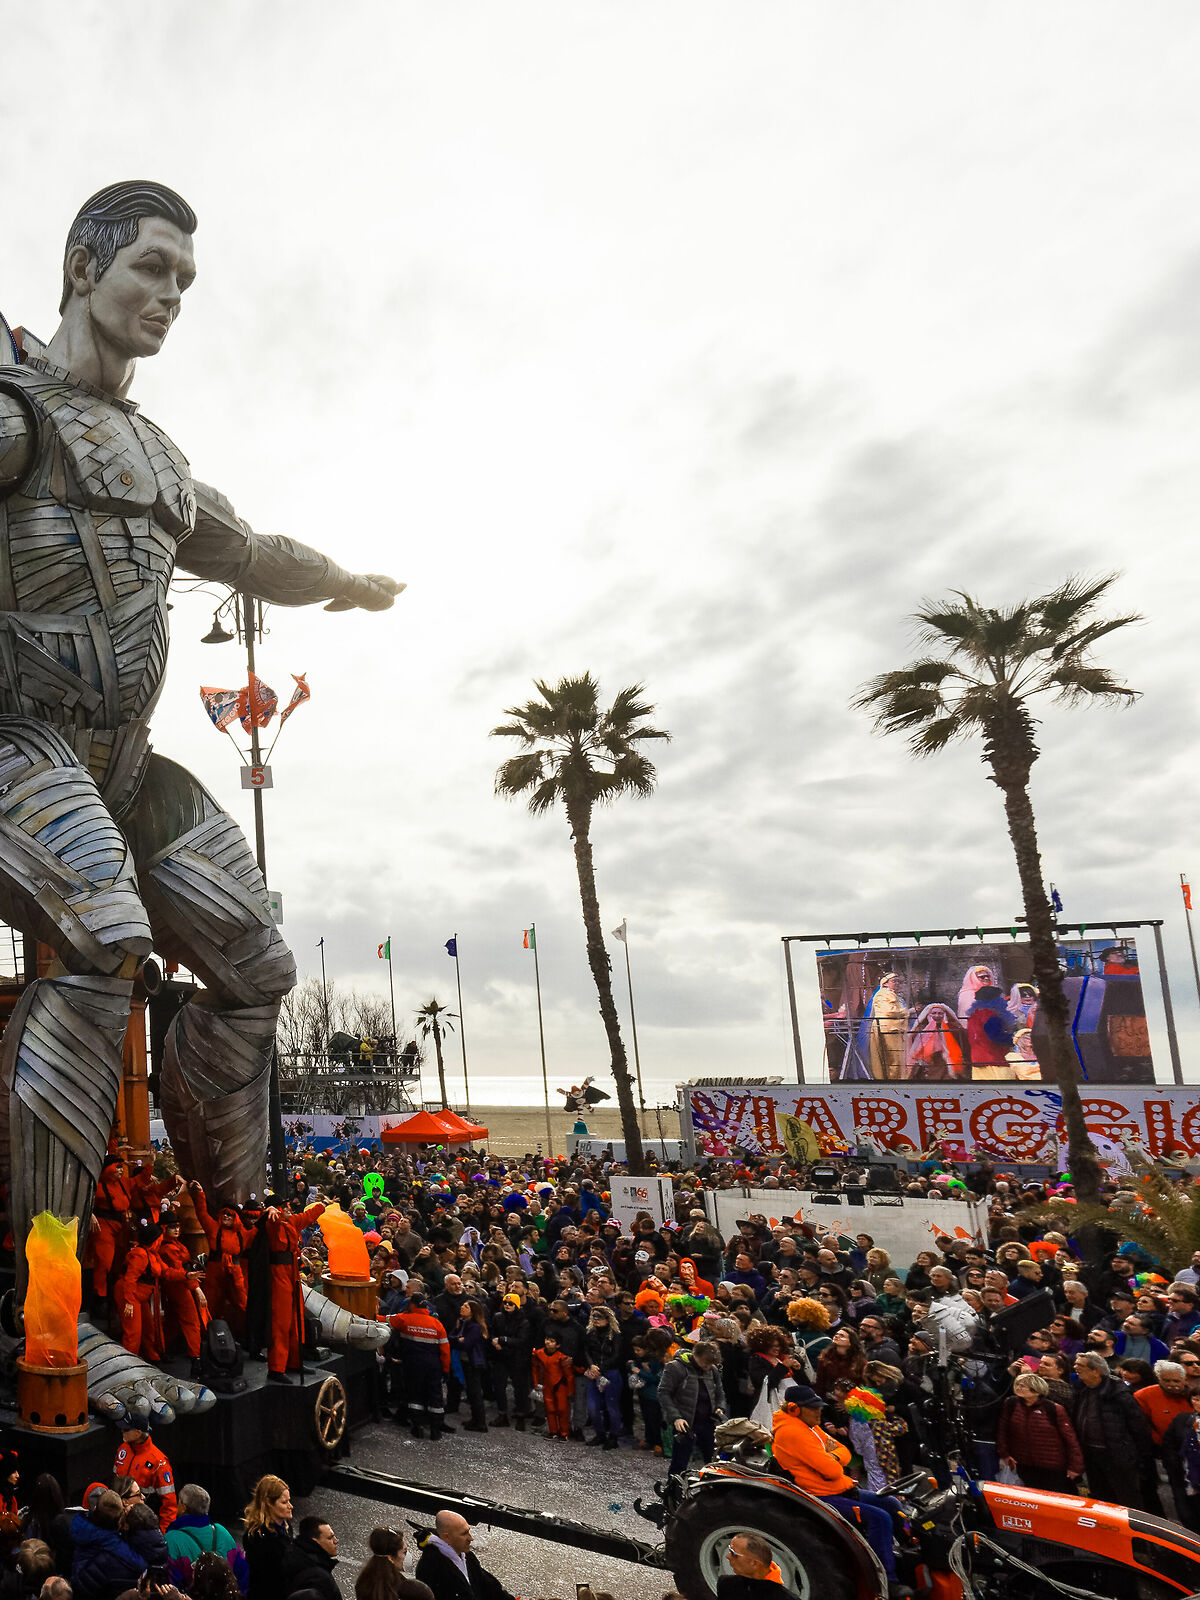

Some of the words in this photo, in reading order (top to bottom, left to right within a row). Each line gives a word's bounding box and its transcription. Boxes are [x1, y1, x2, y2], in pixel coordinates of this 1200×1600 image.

[251, 767, 265, 785] 5
[691, 1097, 1200, 1163] VIAREGGI
[994, 1498, 1039, 1510] GOLDONI
